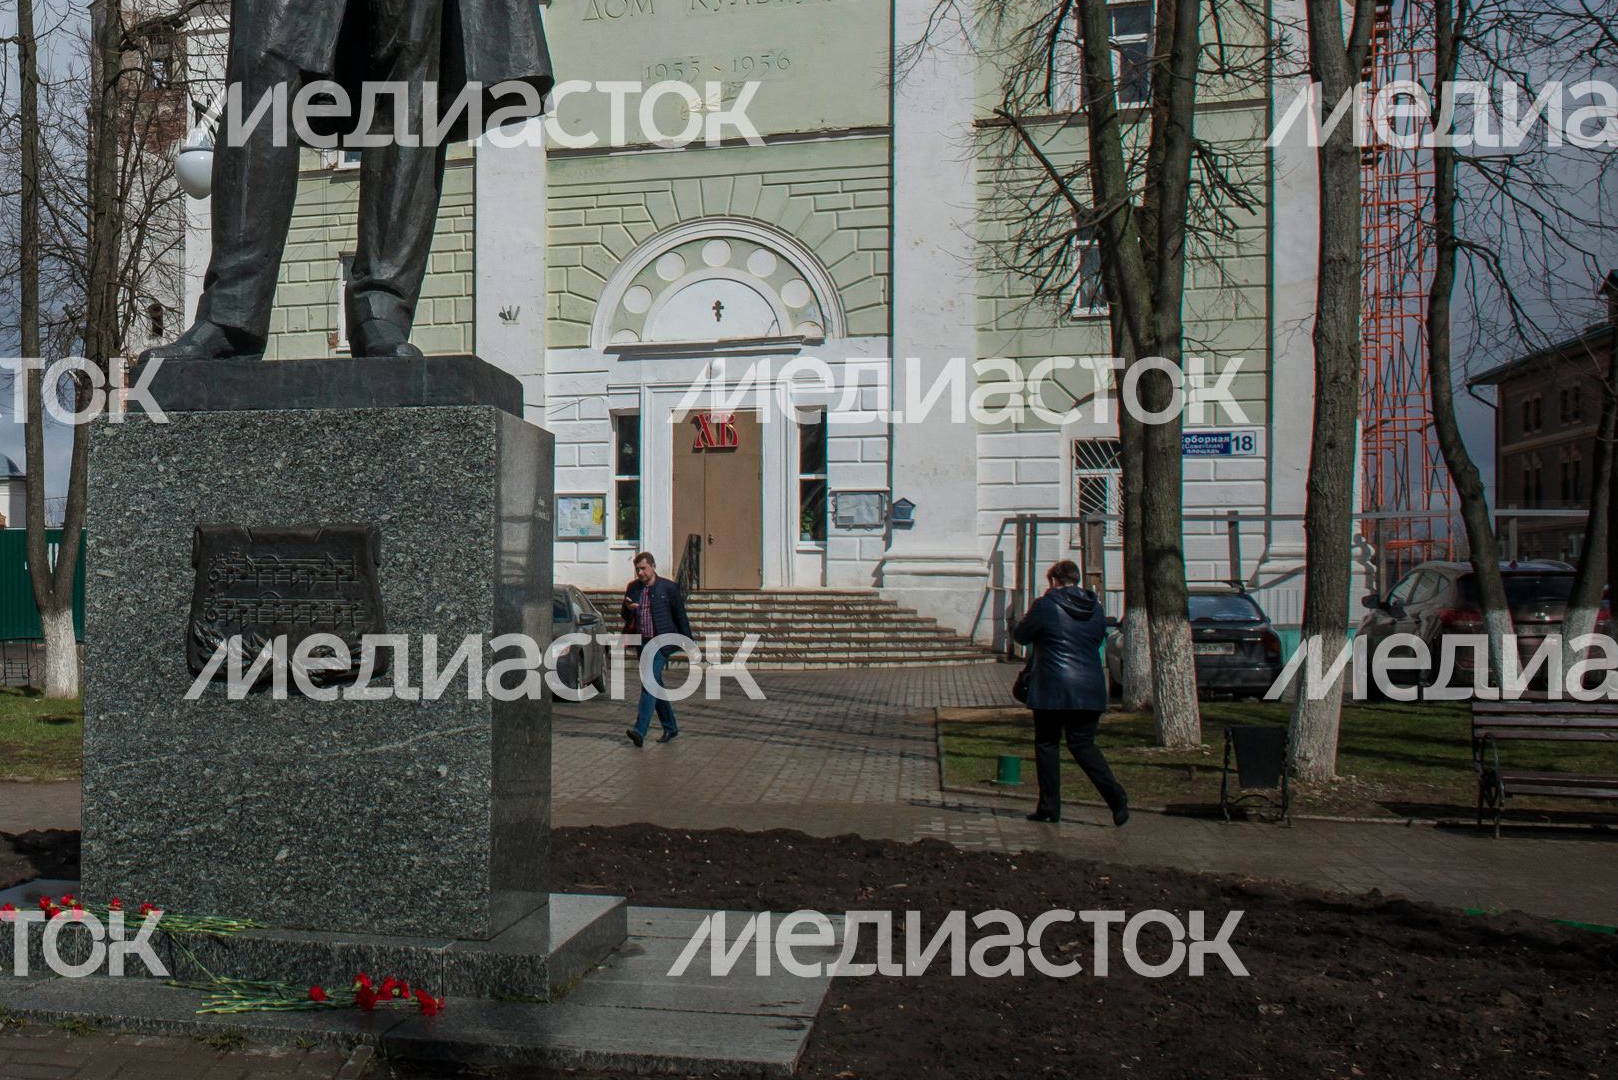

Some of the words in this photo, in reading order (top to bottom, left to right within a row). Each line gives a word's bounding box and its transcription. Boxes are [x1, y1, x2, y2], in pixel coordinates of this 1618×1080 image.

[645, 56, 701, 83] 1955
[732, 50, 791, 79] 1956
[1182, 434, 1230, 444] оборная
[1232, 435, 1253, 451] 18
